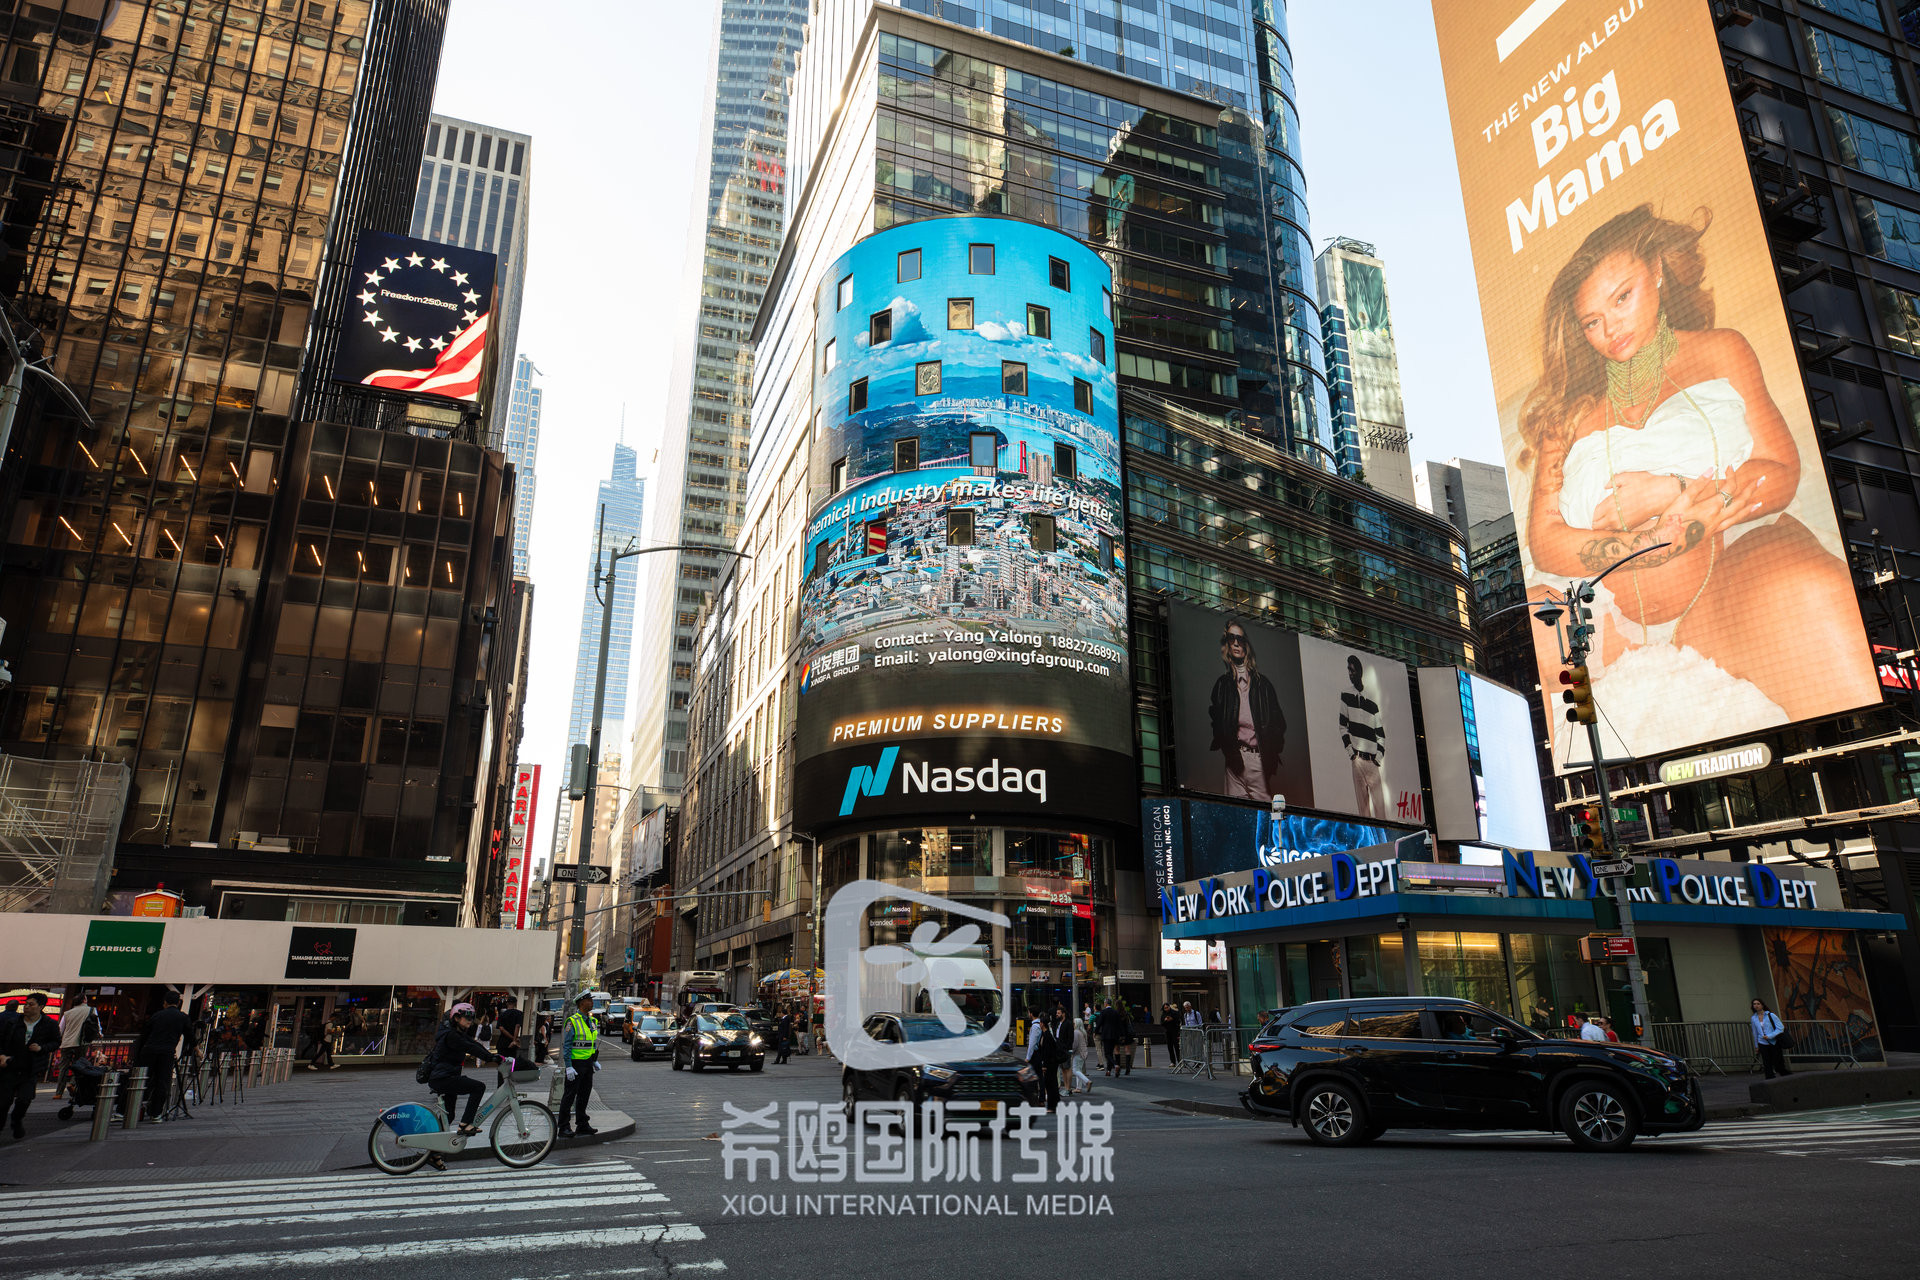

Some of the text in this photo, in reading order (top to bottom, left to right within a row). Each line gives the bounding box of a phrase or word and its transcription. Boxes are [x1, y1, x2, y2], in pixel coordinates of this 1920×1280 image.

[1482, 102, 1521, 143] THE
[1522, 54, 1571, 111] NEW
[1531, 69, 1621, 169] Big
[1505, 98, 1681, 255] Mama
[380, 289, 459, 311] Freedom250.org
[860, 481, 944, 512] industry
[951, 480, 1026, 500] makes
[1032, 484, 1063, 506] life
[1068, 495, 1114, 524] better
[810, 644, 860, 677] 兴发集团
[874, 630, 1121, 664] Contact: Yang Yalong 18827268921
[874, 648, 1110, 677] Email: yalong@xingfagroup.com
[810, 664, 860, 688] XINGFA GROUP
[832, 713, 1063, 742] PREMIUM SUPPLIERS
[902, 758, 1047, 804] Nasdaq
[513, 772, 530, 826] PARK
[1163, 805, 1171, 825] (IGC)
[1396, 790, 1422, 822] H&M
[1153, 806, 1164, 867] AMERICAN
[503, 857, 521, 913] PARK
[1502, 848, 1576, 899] NEW
[1653, 858, 1750, 907] POLICE
[1746, 863, 1818, 909] DEPT
[1595, 862, 1631, 875] ONE WAY
[1161, 853, 1397, 925] NEW YORK POLICE DEPT
[892, 906, 911, 914] Nasdaq
[1026, 906, 1047, 914] Nasdaq
[90, 945, 142, 953] STARBUCKS
